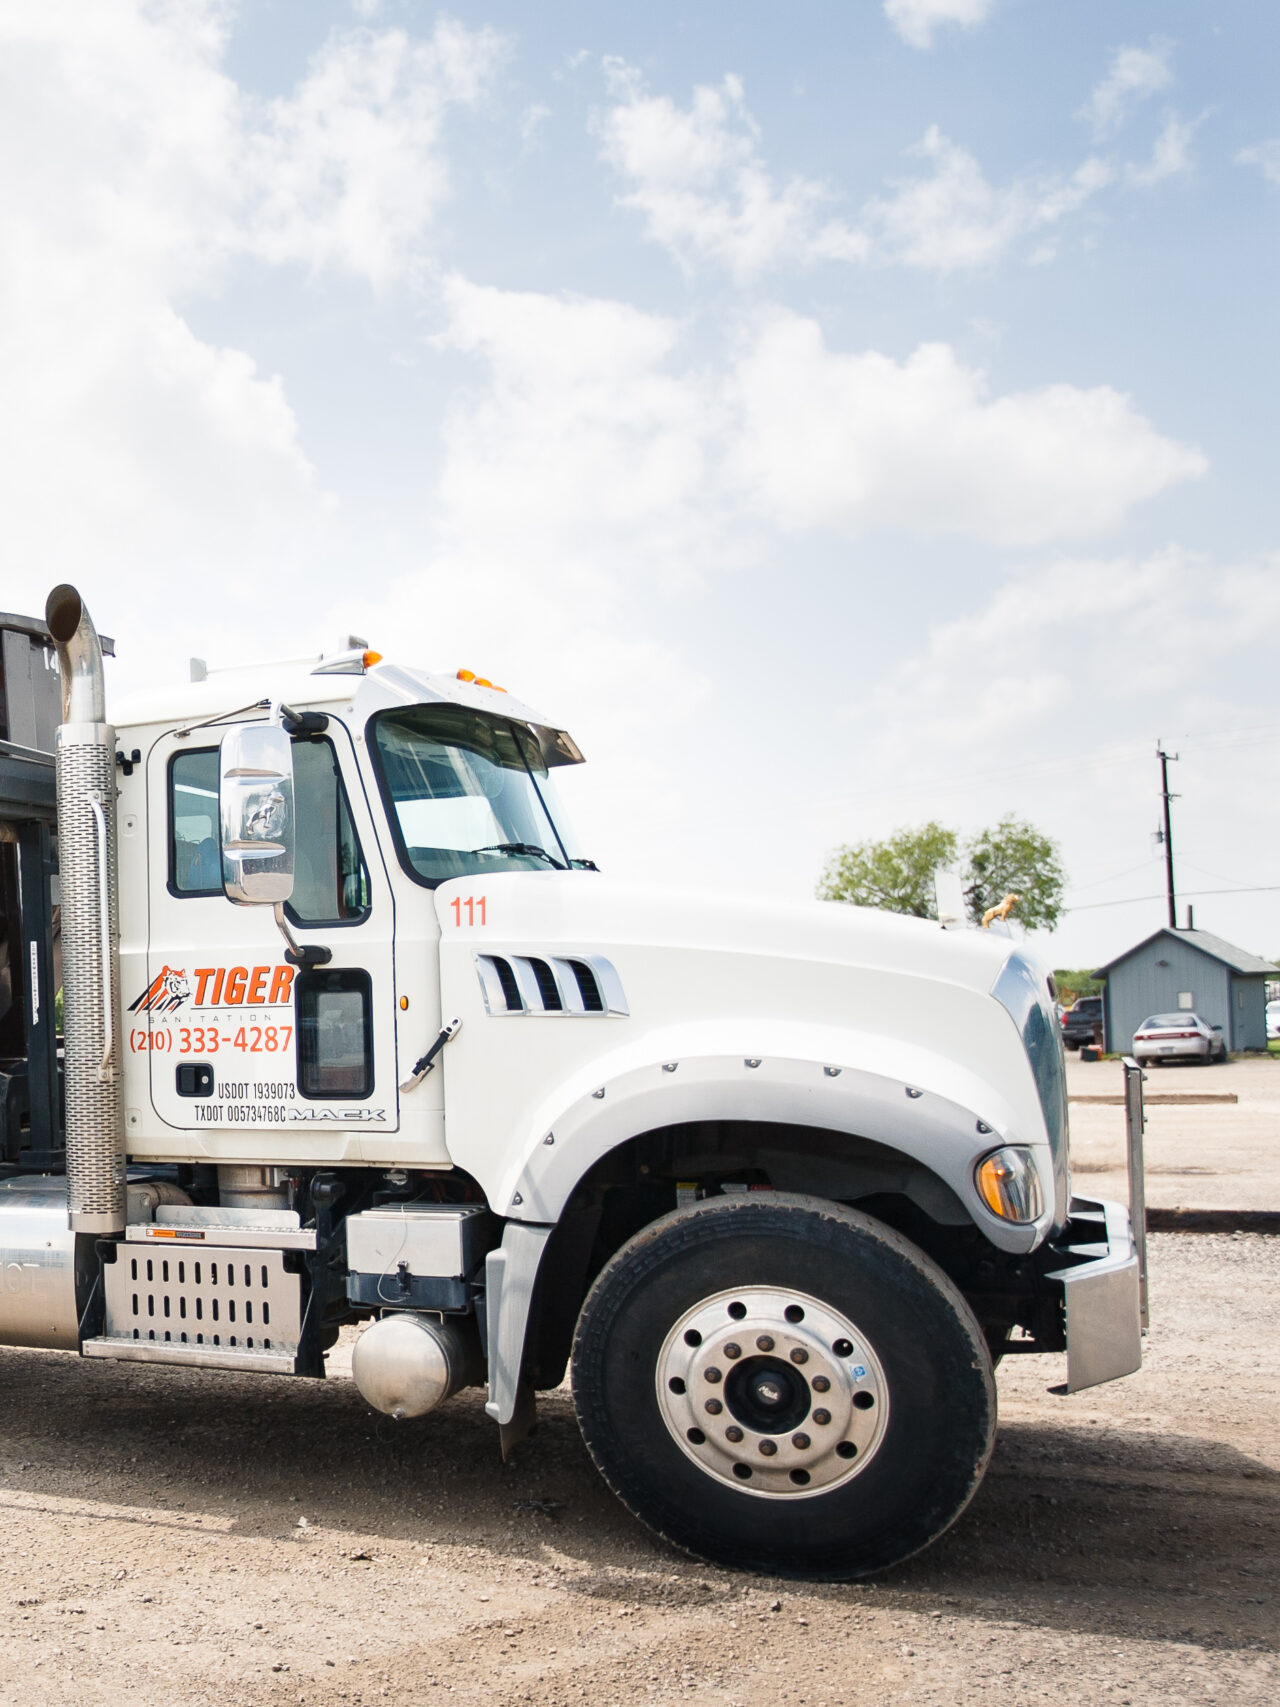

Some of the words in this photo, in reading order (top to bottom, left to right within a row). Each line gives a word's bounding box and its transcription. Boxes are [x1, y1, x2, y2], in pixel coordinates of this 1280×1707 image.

[450, 896, 486, 927] 111
[194, 965, 295, 1006] TIGER
[148, 1014, 272, 1023] SANITATION
[130, 1028, 173, 1053] (210)
[179, 1026, 293, 1053] 333-4287
[218, 1082, 249, 1099] USDOT
[253, 1082, 296, 1099] 1939073
[194, 1105, 224, 1122] TXDOT
[288, 1108, 386, 1122] MACK
